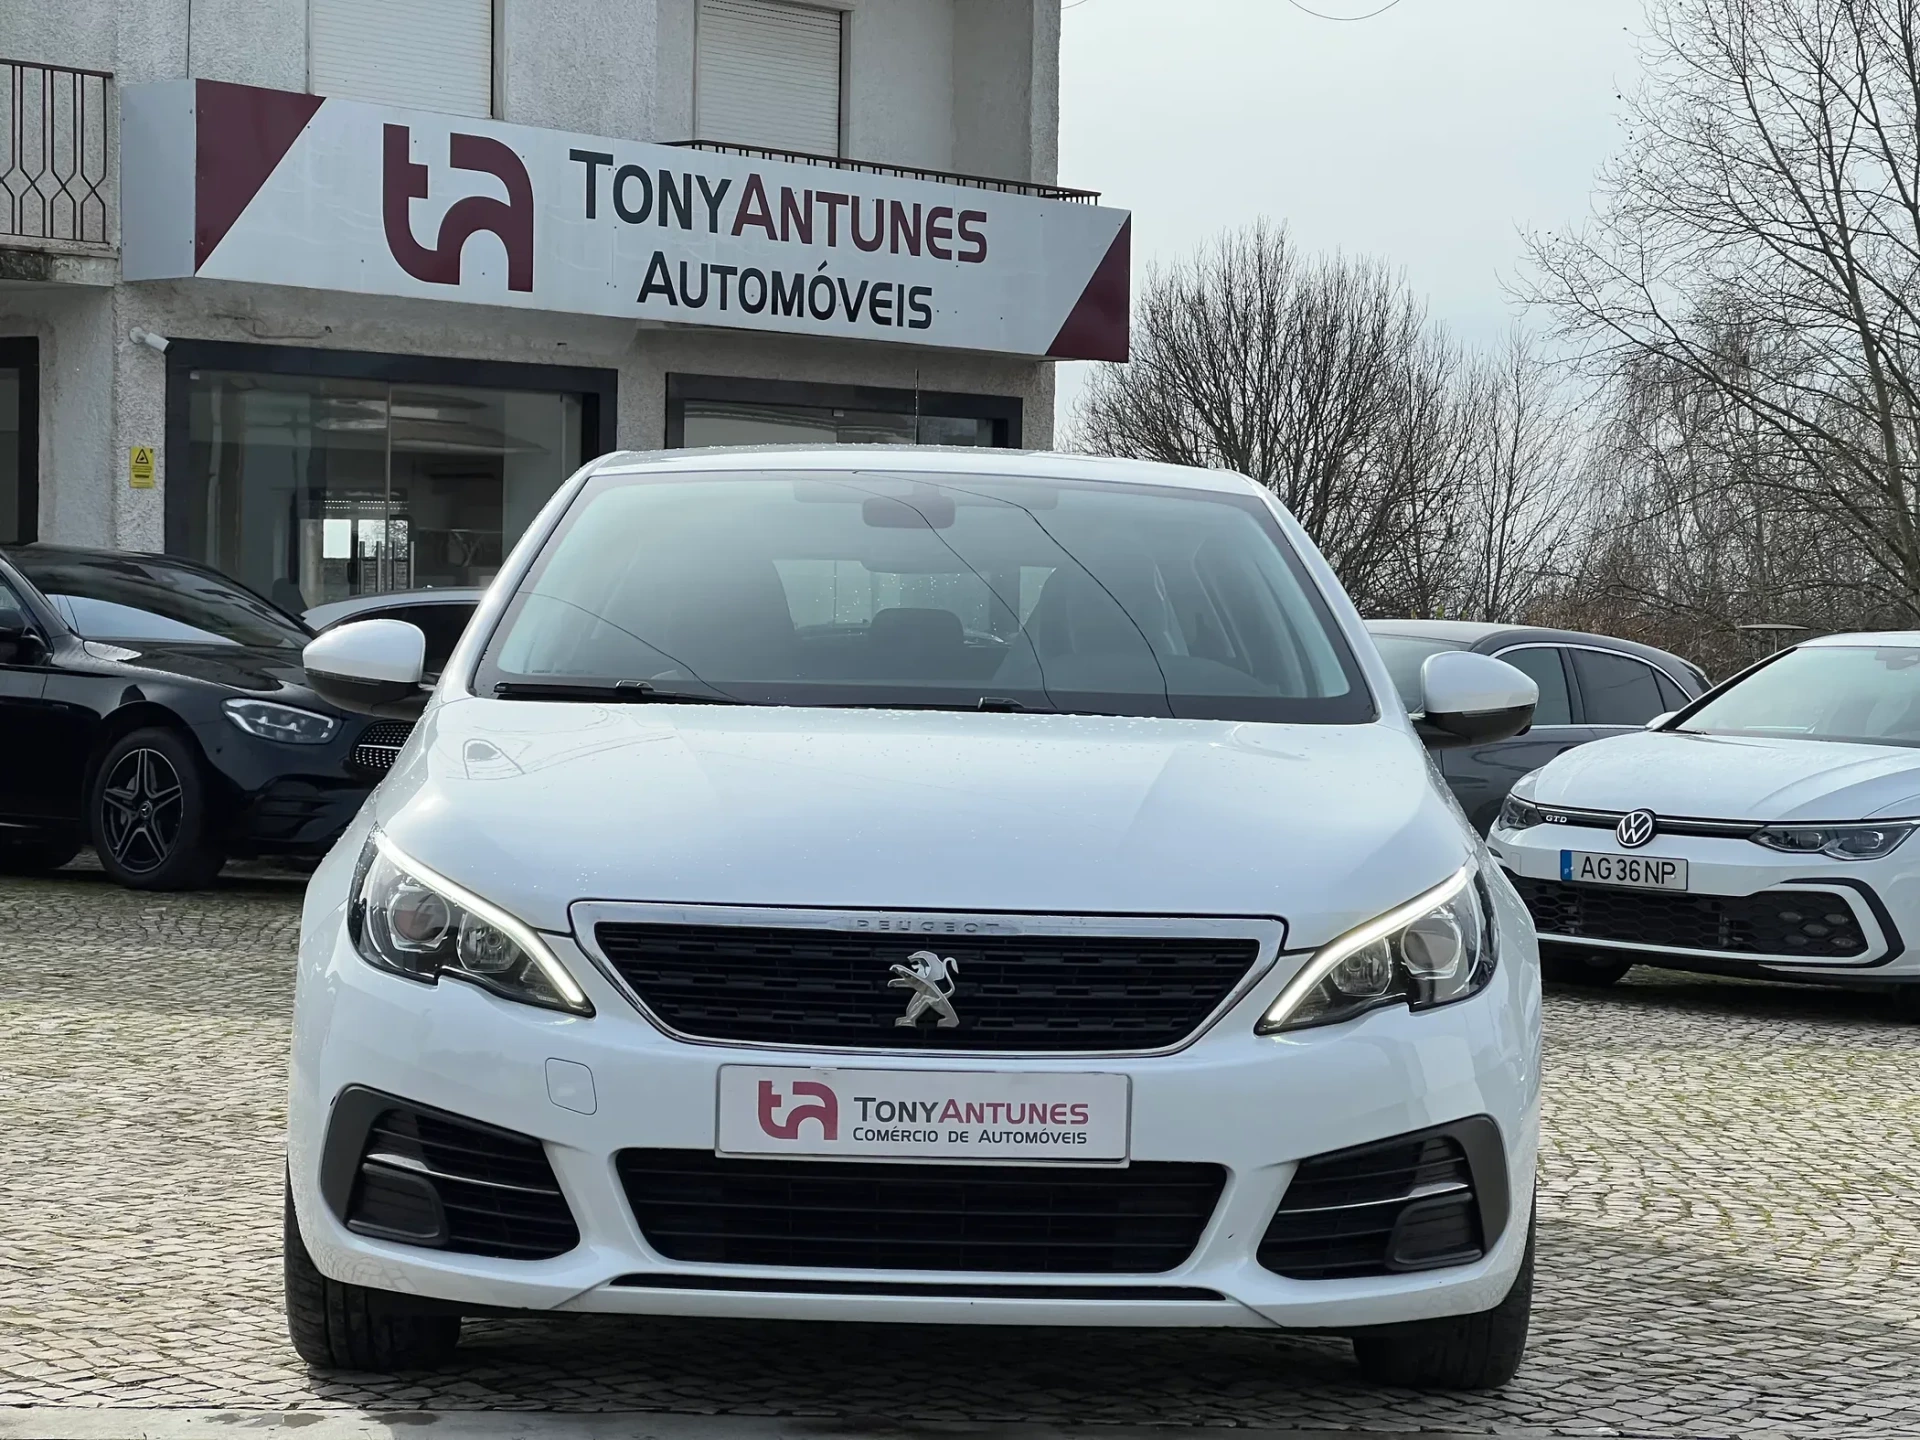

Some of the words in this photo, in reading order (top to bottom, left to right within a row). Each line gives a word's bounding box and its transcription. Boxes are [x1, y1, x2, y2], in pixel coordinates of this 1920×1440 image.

[637, 250, 933, 330] AUTOMÓVEIS
[1545, 814, 1568, 823] GTD
[857, 919, 1000, 933] PEUGEOT
[853, 1126, 939, 1143] COMÉRCIO
[948, 1131, 969, 1143] DE
[978, 1128, 1087, 1144] AUTOMÓVEIS
